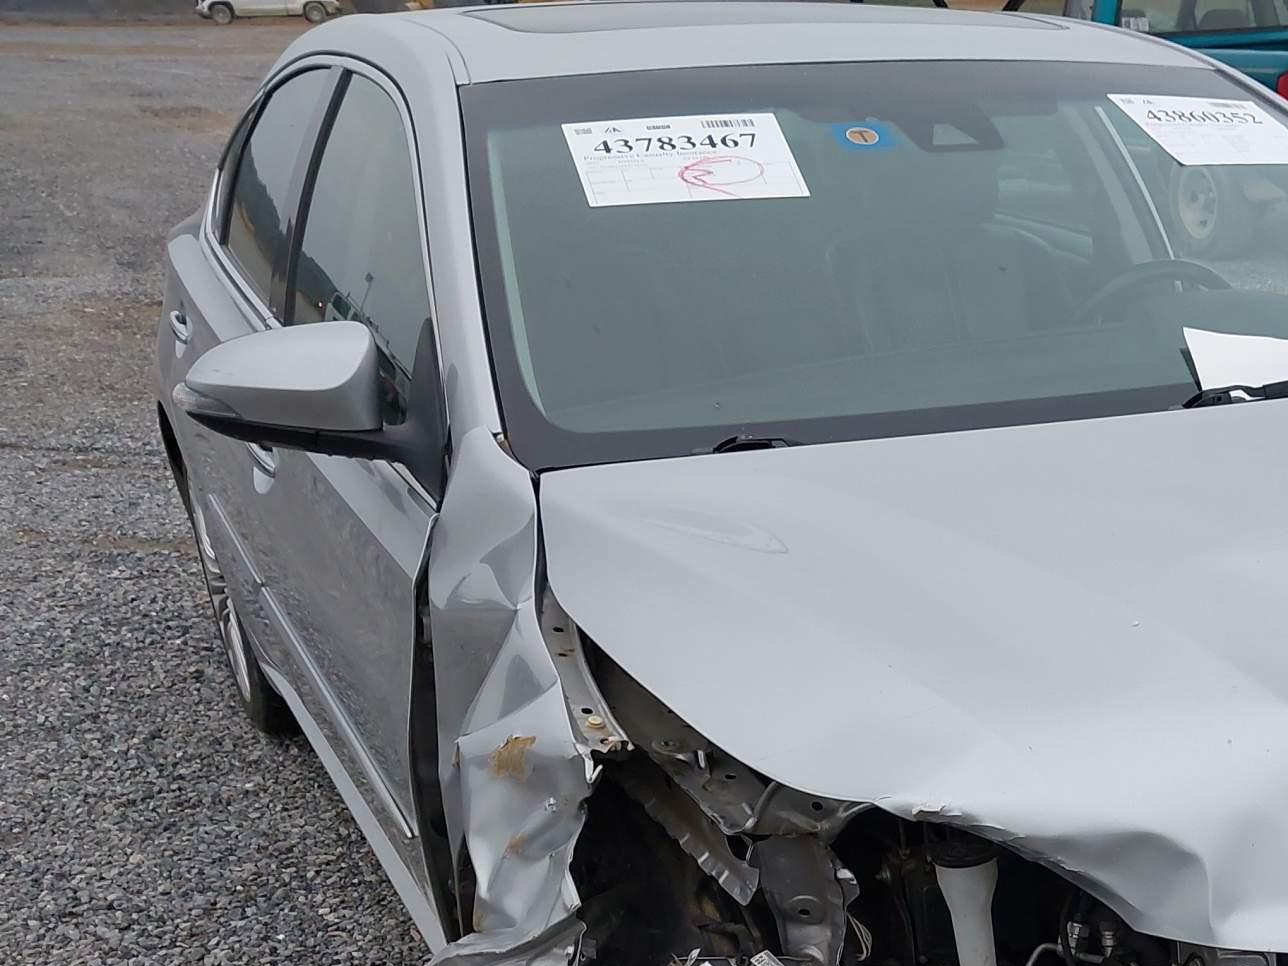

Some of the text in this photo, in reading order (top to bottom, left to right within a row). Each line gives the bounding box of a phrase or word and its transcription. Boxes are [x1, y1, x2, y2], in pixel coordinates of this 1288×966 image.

[1147, 109, 1263, 125] 43860352
[593, 133, 757, 154] 43783467
[849, 130, 868, 143] T
